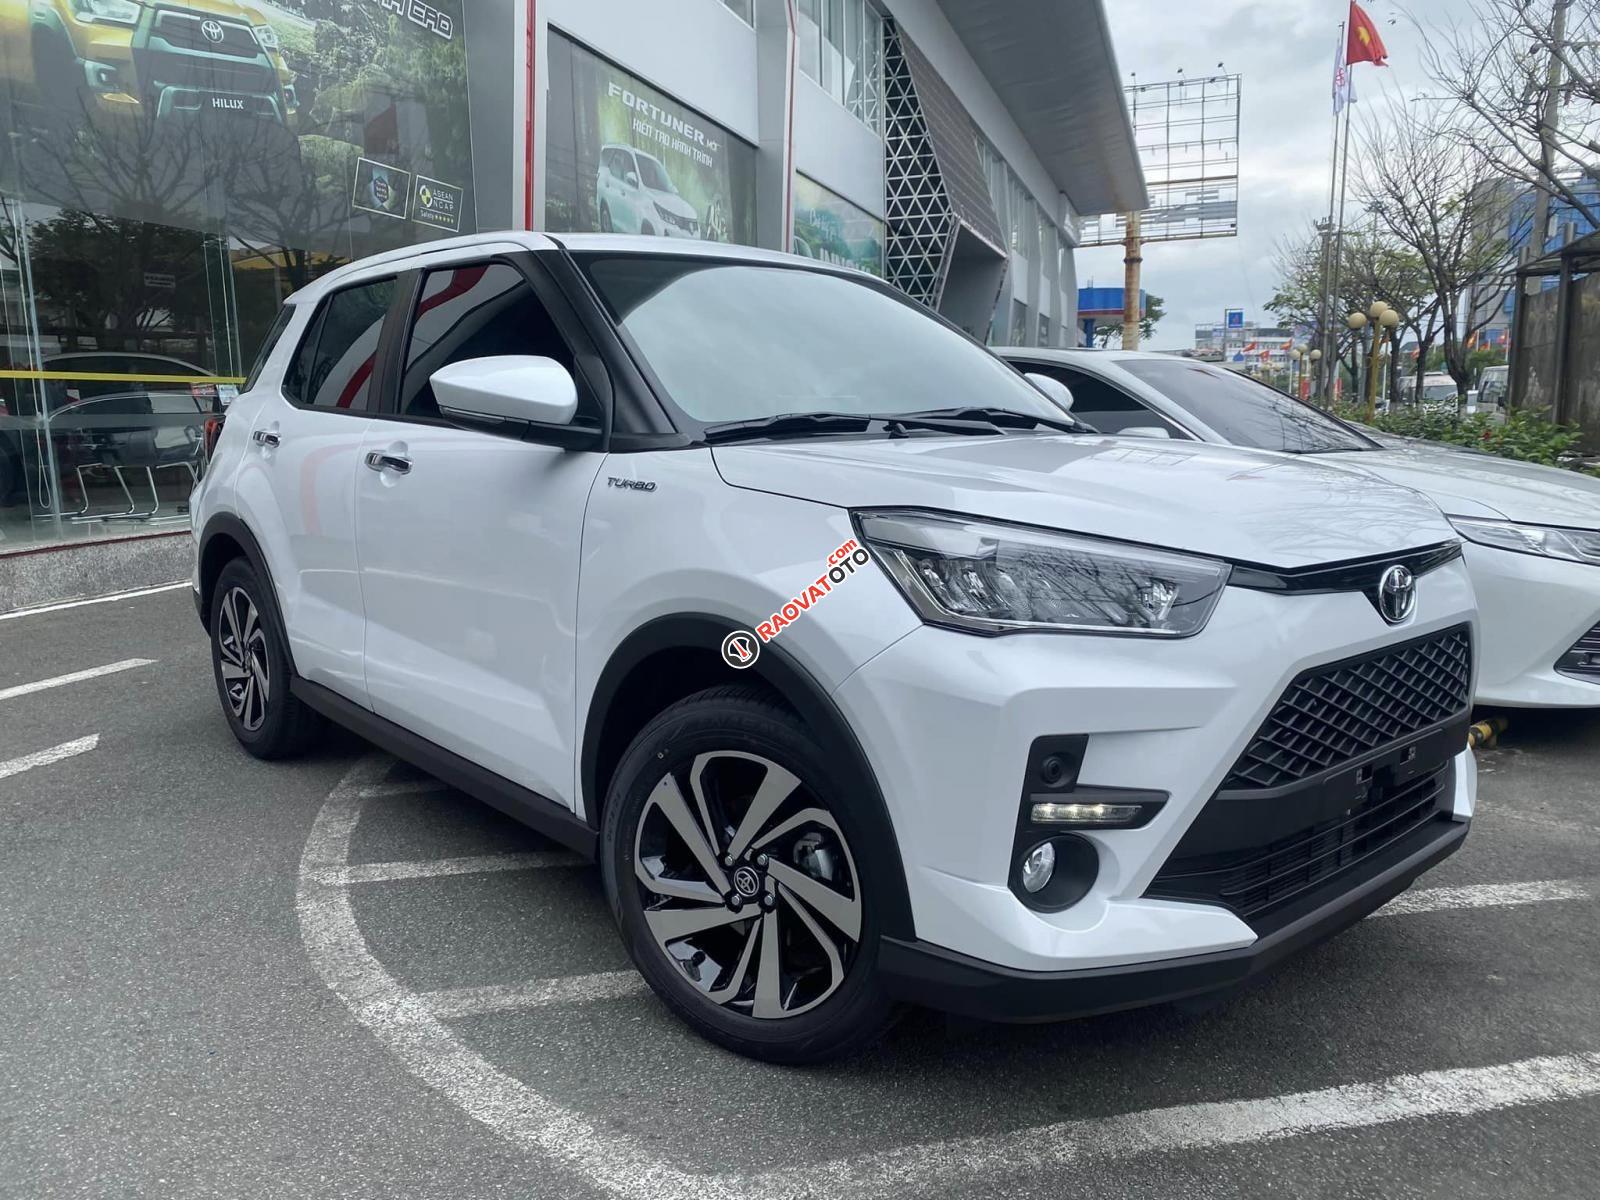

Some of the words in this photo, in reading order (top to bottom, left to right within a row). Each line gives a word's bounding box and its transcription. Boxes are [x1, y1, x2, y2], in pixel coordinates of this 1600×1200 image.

[211, 97, 244, 110] HILUX
[607, 81, 704, 146] FORTUNER
[432, 188, 454, 202] ASEAN
[432, 199, 454, 212] NCAP
[607, 476, 658, 492] TURBO
